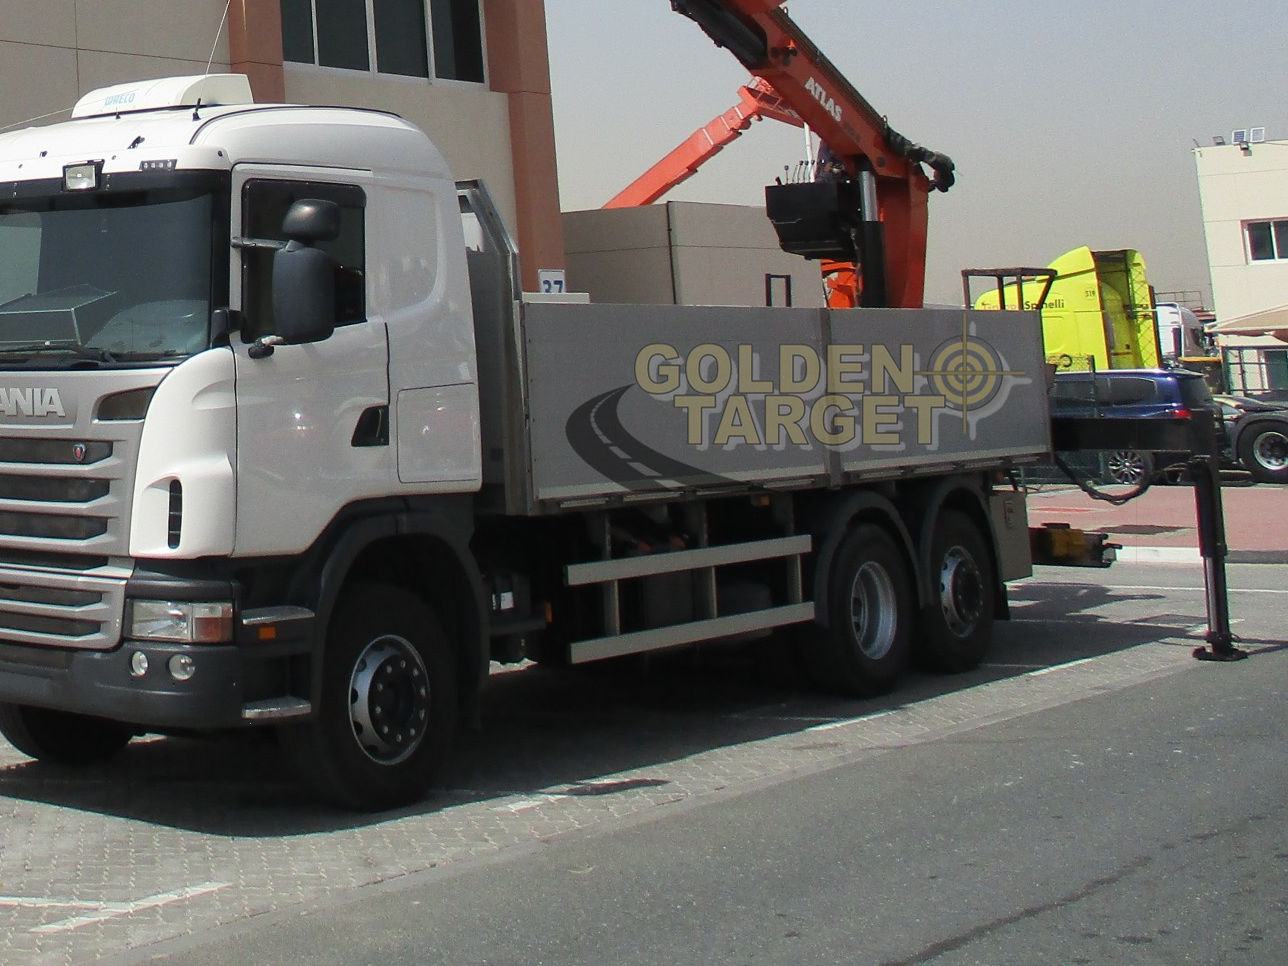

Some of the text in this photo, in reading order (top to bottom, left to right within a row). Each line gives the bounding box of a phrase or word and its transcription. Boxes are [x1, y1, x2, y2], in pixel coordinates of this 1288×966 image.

[804, 76, 843, 122] ATLAS
[542, 279, 564, 293] 37
[1024, 298, 1065, 311] Spnelli
